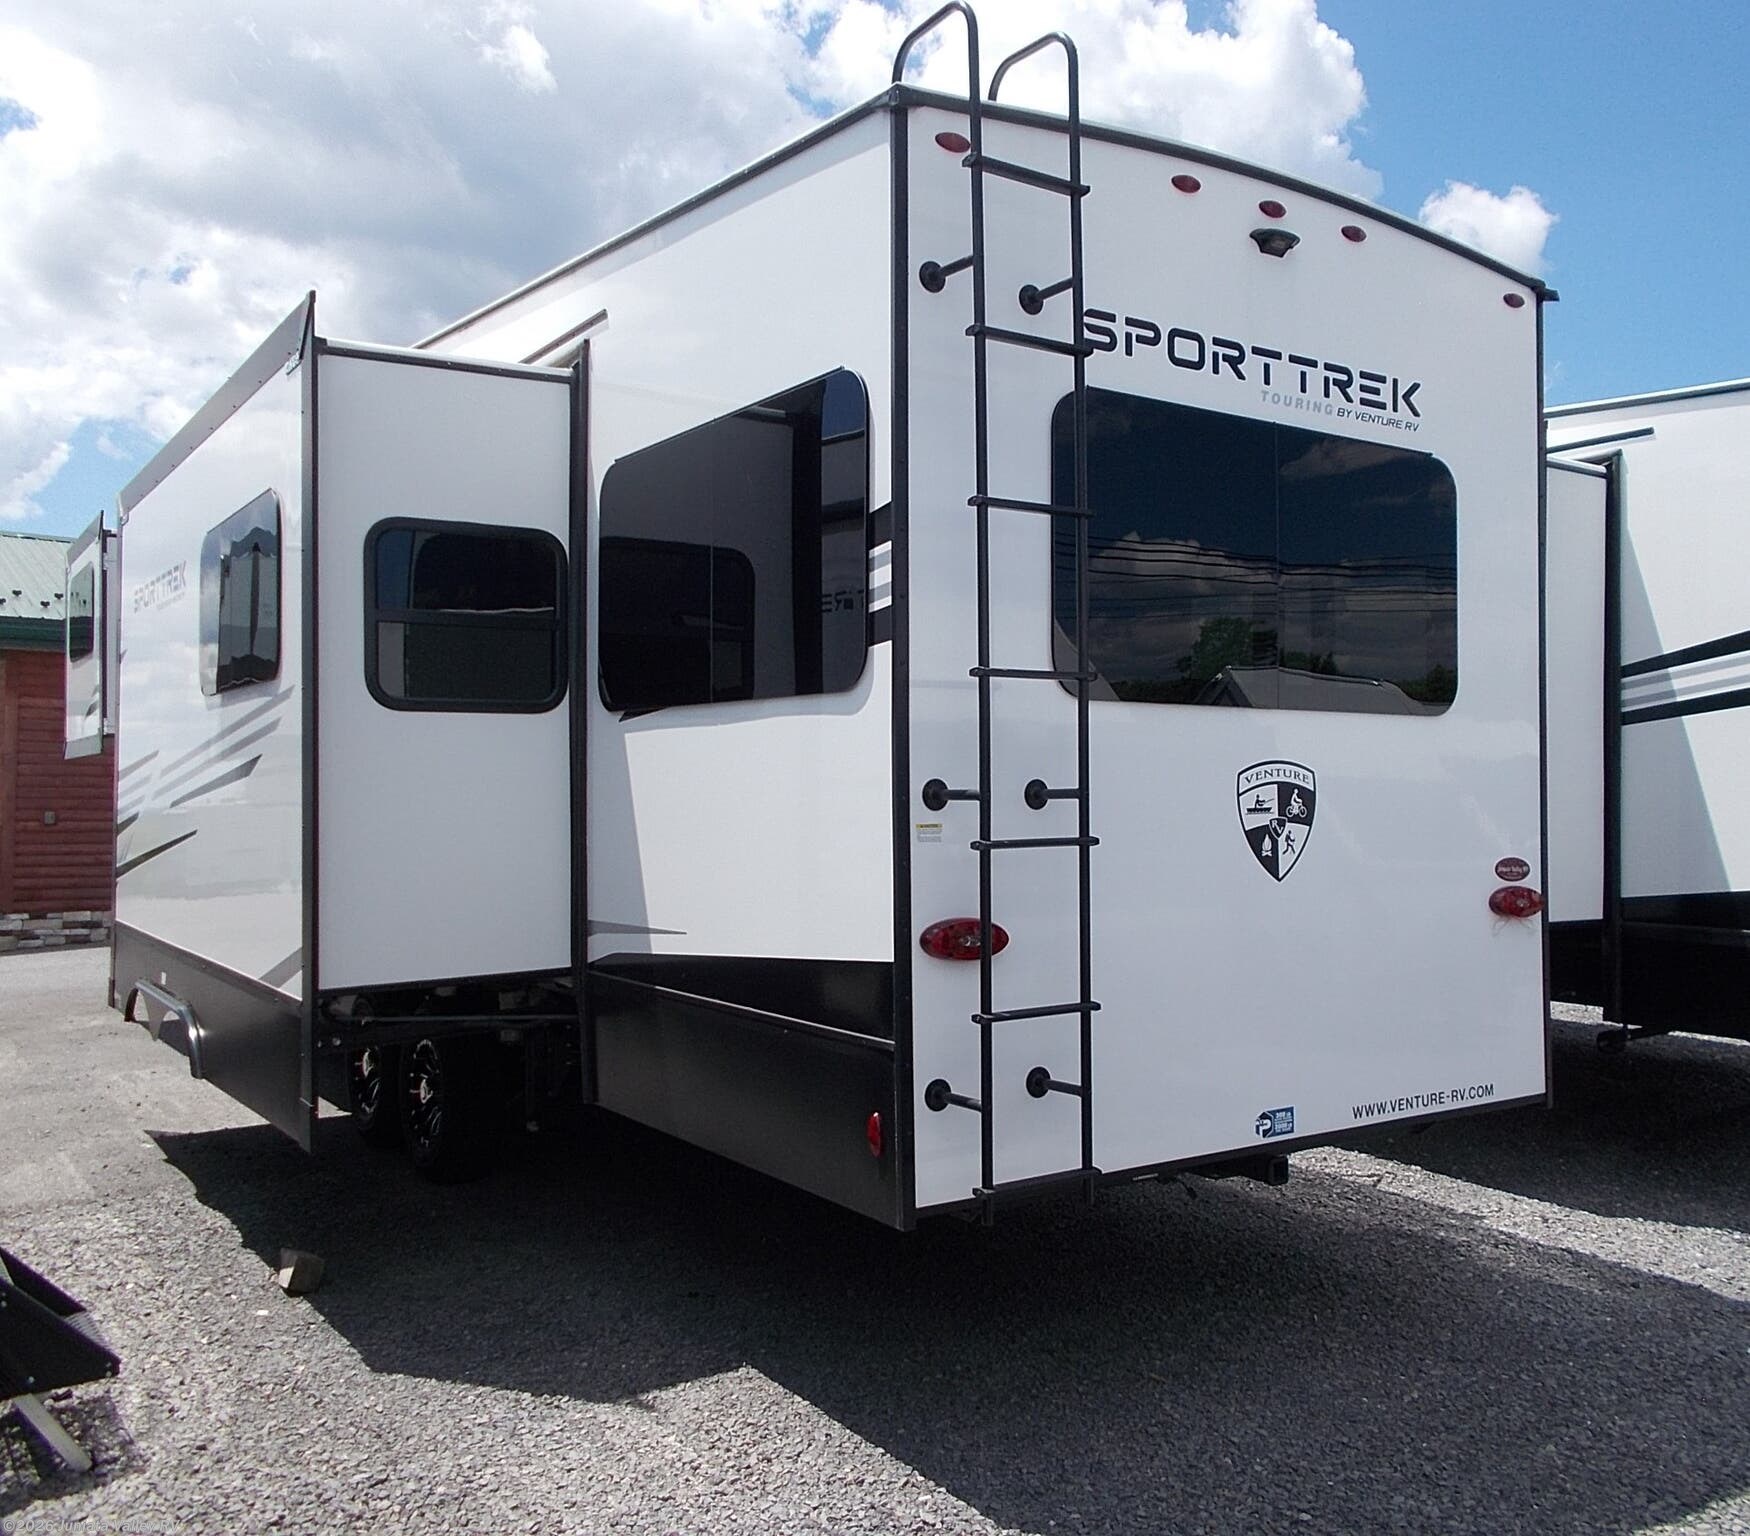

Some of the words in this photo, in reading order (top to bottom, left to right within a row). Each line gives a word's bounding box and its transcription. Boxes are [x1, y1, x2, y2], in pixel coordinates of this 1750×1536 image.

[1083, 308, 1421, 417] SPORTTREK
[1261, 390, 1333, 415] TOURING
[1336, 407, 1352, 417] BY
[1354, 411, 1402, 429] VENTURE
[1404, 421, 1420, 432] RV
[1245, 768, 1310, 784] VENTURE
[1352, 1083, 1494, 1120] WWW.VENTURE-RV.COM
